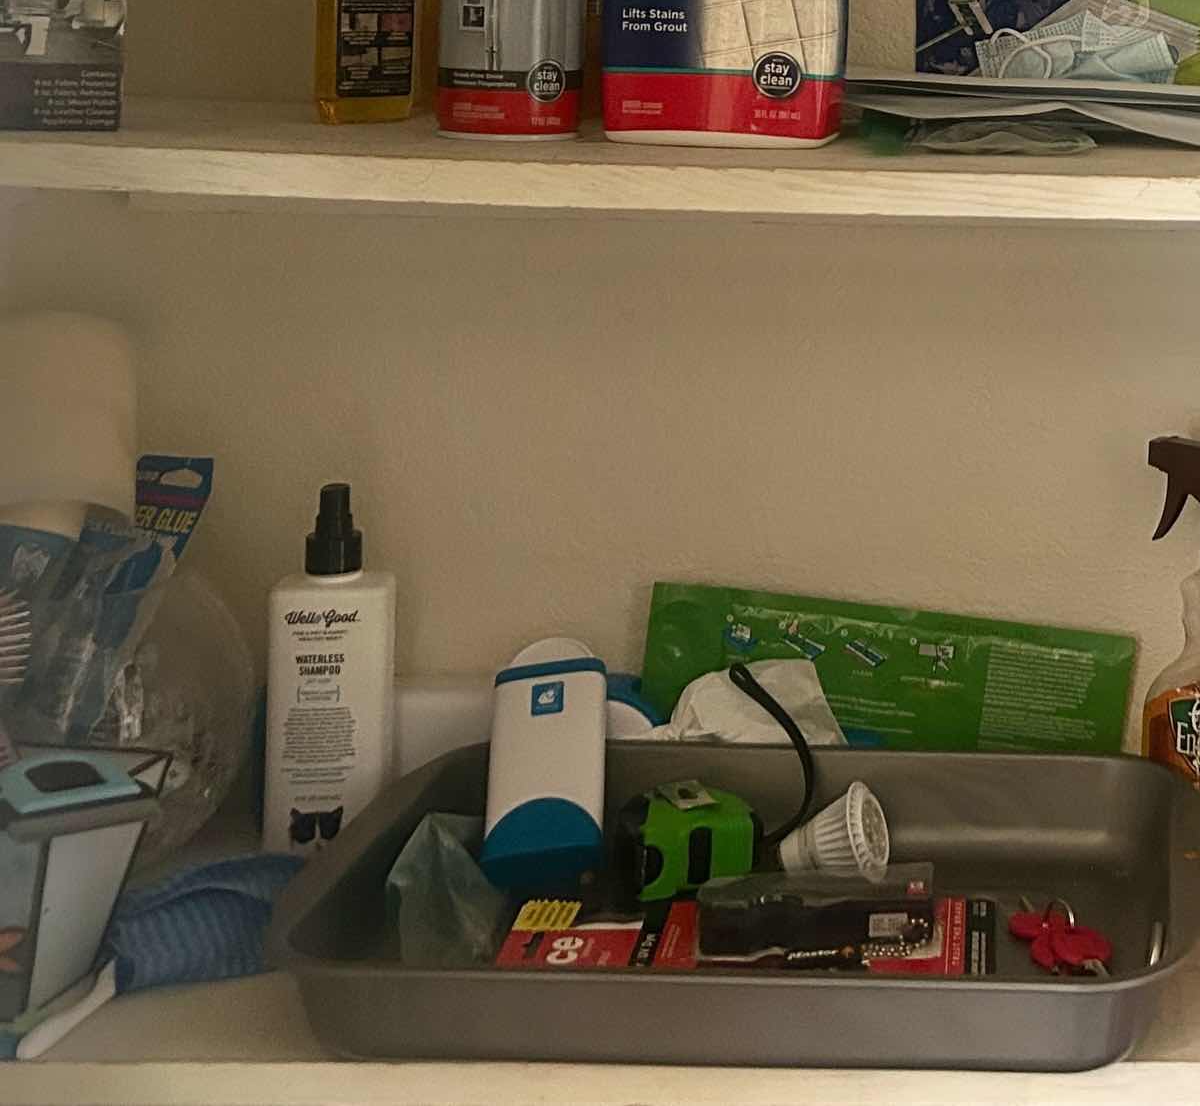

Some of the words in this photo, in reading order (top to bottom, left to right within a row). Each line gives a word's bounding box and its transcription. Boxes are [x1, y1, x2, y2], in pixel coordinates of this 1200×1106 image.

[622, 9, 647, 20] Lifts
[649, 9, 685, 20] Stains
[622, 21, 651, 32] From
[653, 21, 688, 33] Grout
[764, 62, 790, 76] stay
[536, 69, 558, 83] stay
[759, 74, 792, 87] clean
[533, 80, 560, 92] clean
[155, 507, 198, 535] GLUE
[296, 653, 345, 664] WATERLESS
[299, 665, 341, 676] SHAMPOO
